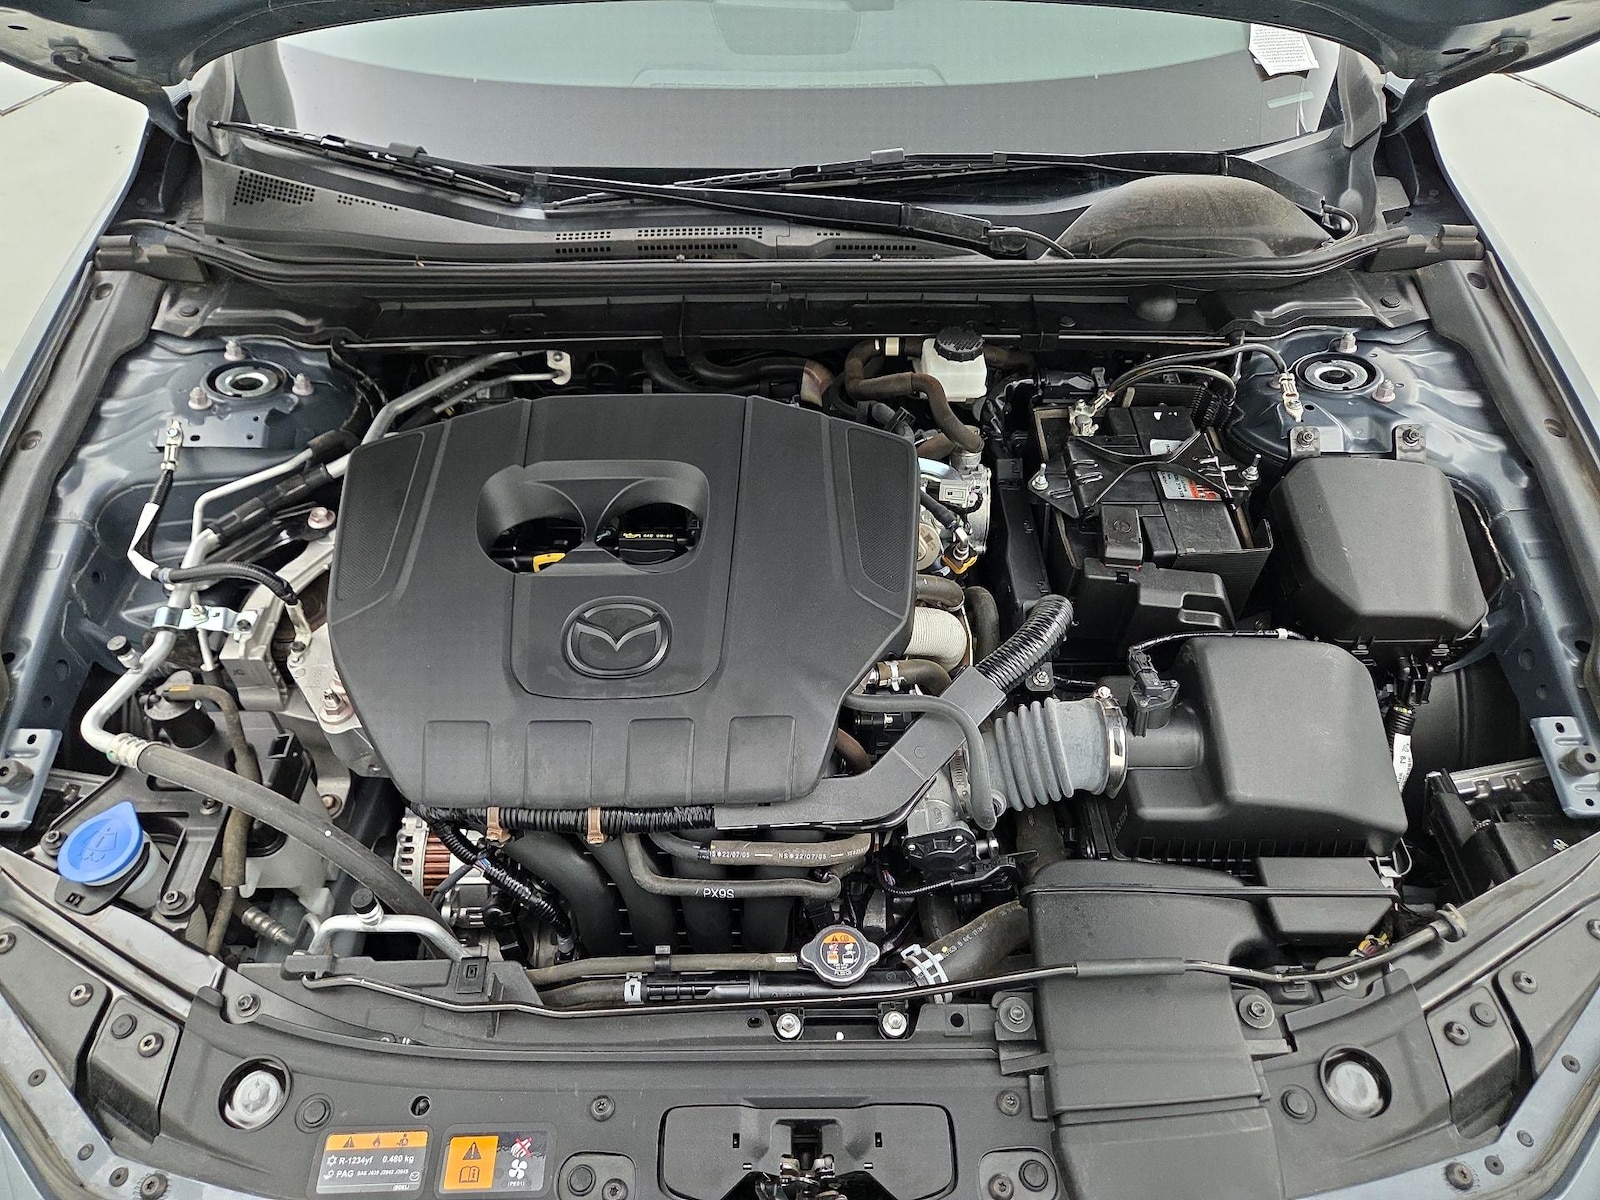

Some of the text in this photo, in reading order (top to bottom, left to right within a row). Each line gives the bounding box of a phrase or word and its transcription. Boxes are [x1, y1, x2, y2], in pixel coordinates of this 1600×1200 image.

[703, 887, 735, 899] PX9S
[338, 1155, 374, 1165] R-1234yf
[404, 1154, 415, 1164] kg
[336, 1169, 354, 1178] PAG
